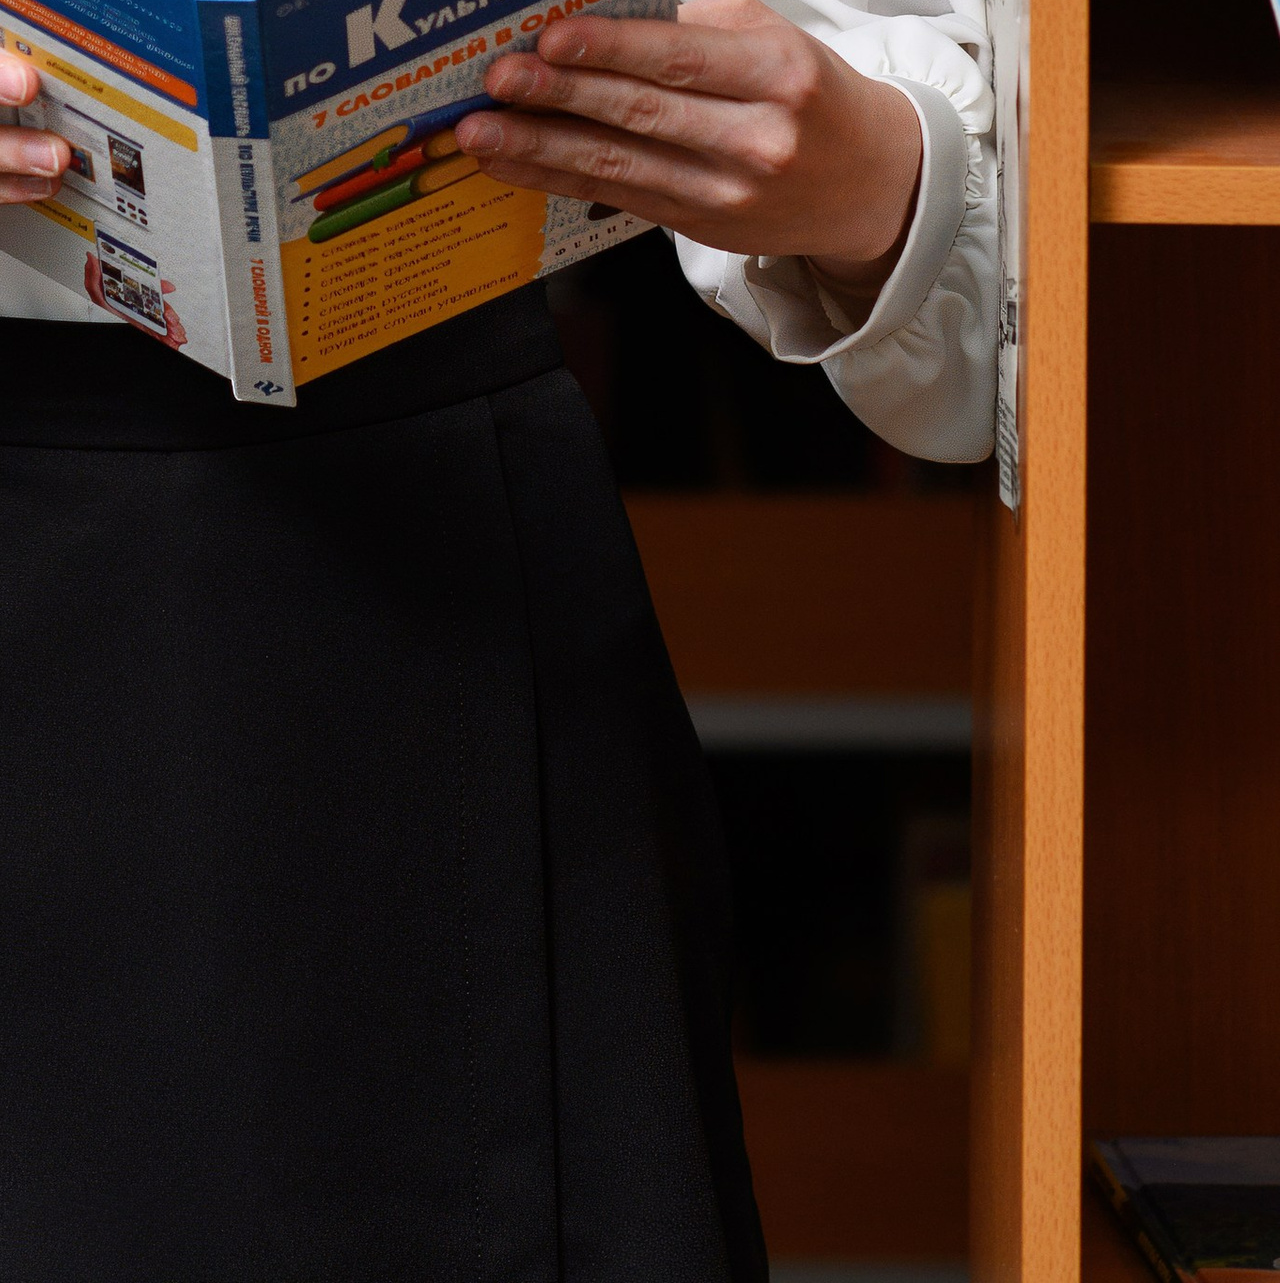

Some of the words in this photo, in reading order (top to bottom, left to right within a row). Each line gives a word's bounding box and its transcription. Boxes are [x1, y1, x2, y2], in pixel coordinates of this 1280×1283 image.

[284, 61, 336, 98] ПО
[312, 112, 328, 129] 7
[336, 32, 487, 118] СЛОВАРЕЙ
[495, 27, 513, 48] В
[555, 217, 635, 256] ФЕНИК
[251, 267, 272, 316] СЛОВАРЕЙ
[256, 327, 273, 364] ОДНОМ
